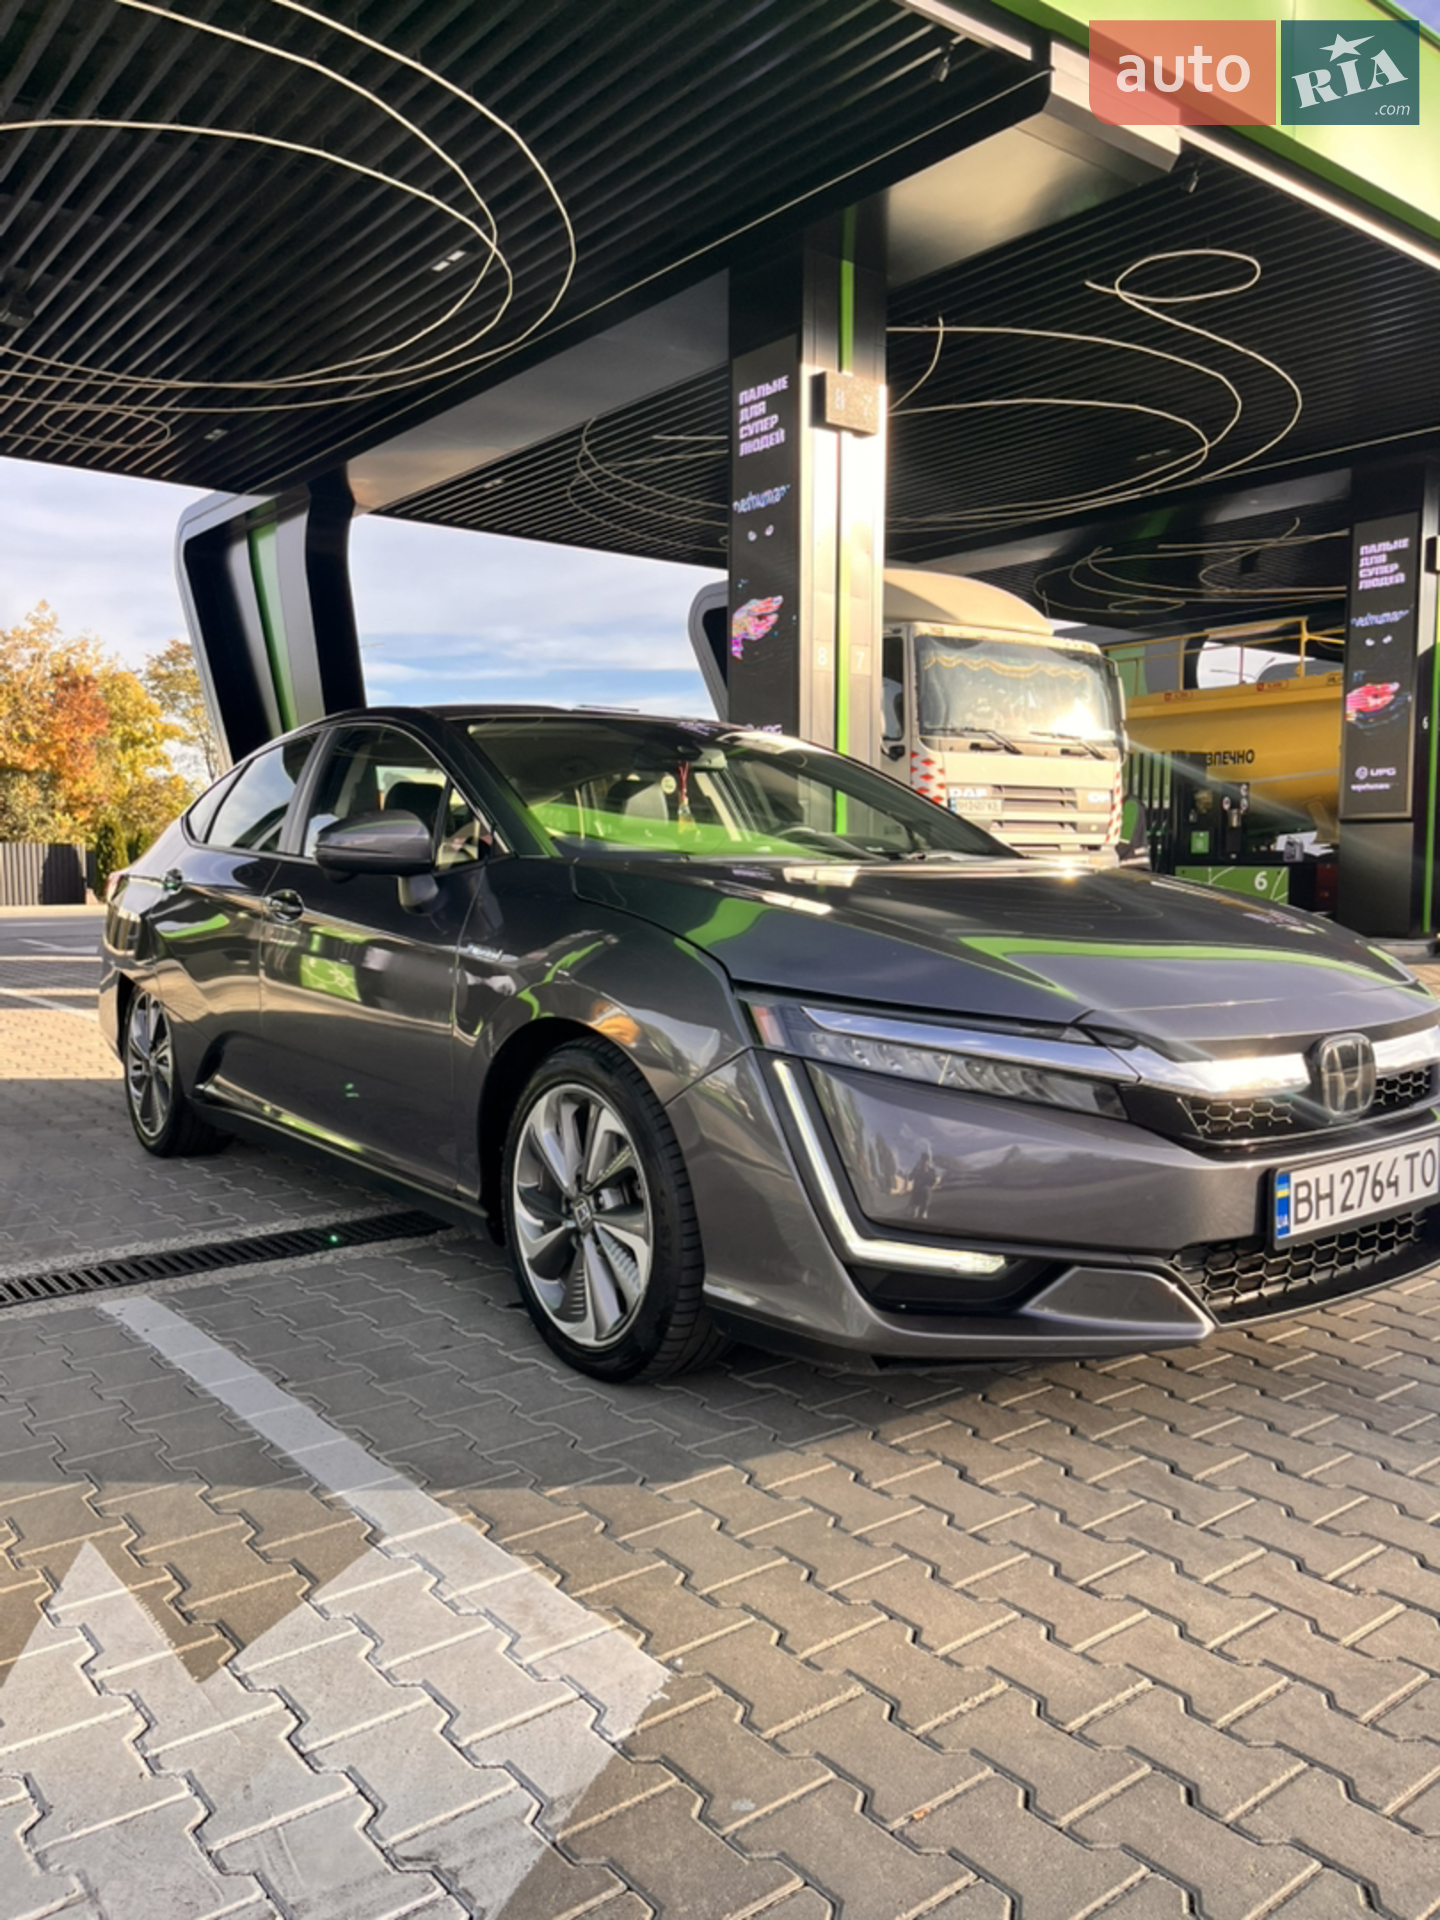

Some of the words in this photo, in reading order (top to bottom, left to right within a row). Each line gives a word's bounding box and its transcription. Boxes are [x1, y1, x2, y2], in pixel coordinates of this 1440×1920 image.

[739, 375, 789, 405] ПАЛЬНЕ
[739, 401, 767, 424] ДЛЯ
[739, 413, 779, 439] СУПЕР
[1254, 871, 1268, 891] 6
[1340, 1157, 1399, 1213] 2764
